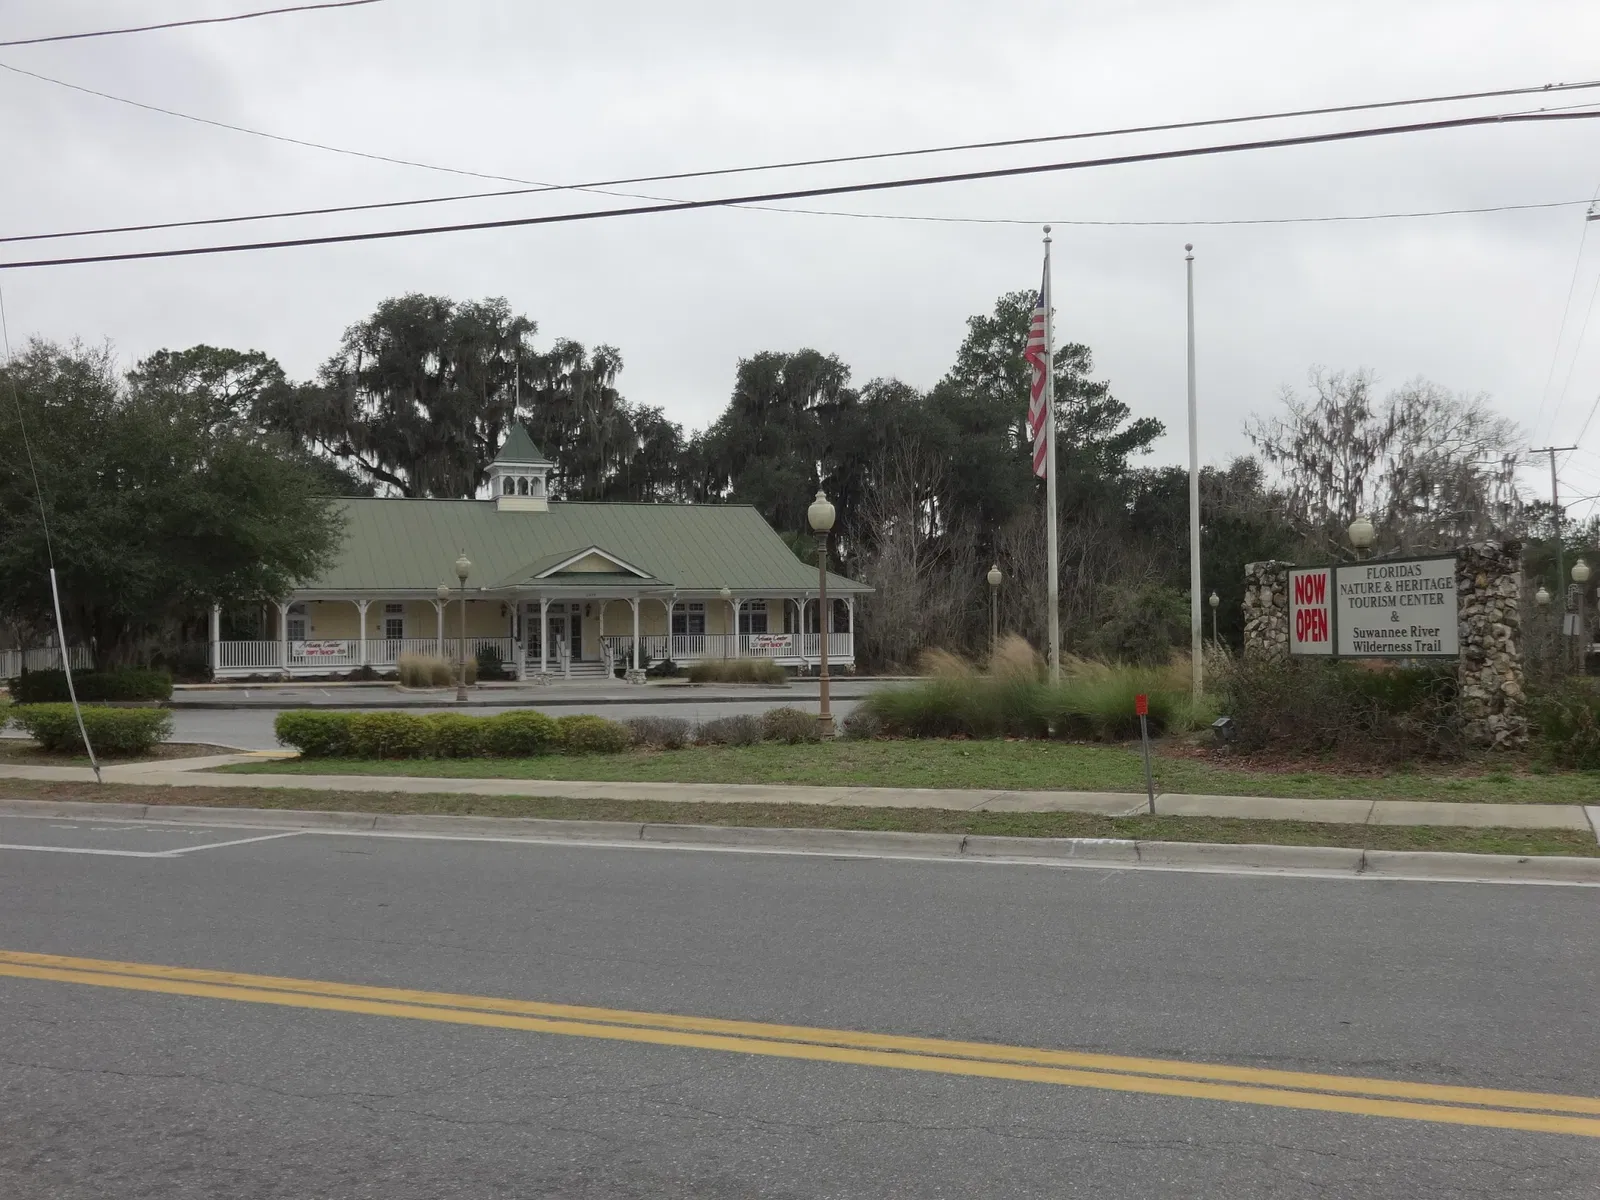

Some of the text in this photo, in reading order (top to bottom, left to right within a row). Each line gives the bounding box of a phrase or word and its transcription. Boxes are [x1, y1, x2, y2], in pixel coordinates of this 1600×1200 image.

[1367, 564, 1422, 579] FLORIDA'S
[1295, 573, 1326, 605] NOW
[1340, 577, 1453, 595] NATURE & HERITAGE
[1348, 593, 1445, 608] TOURISM CENTER
[1390, 610, 1400, 622] &
[1295, 608, 1328, 642] OPEN
[1353, 625, 1440, 639] Suwannee River
[1353, 639, 1441, 653] Wilderness Trail
